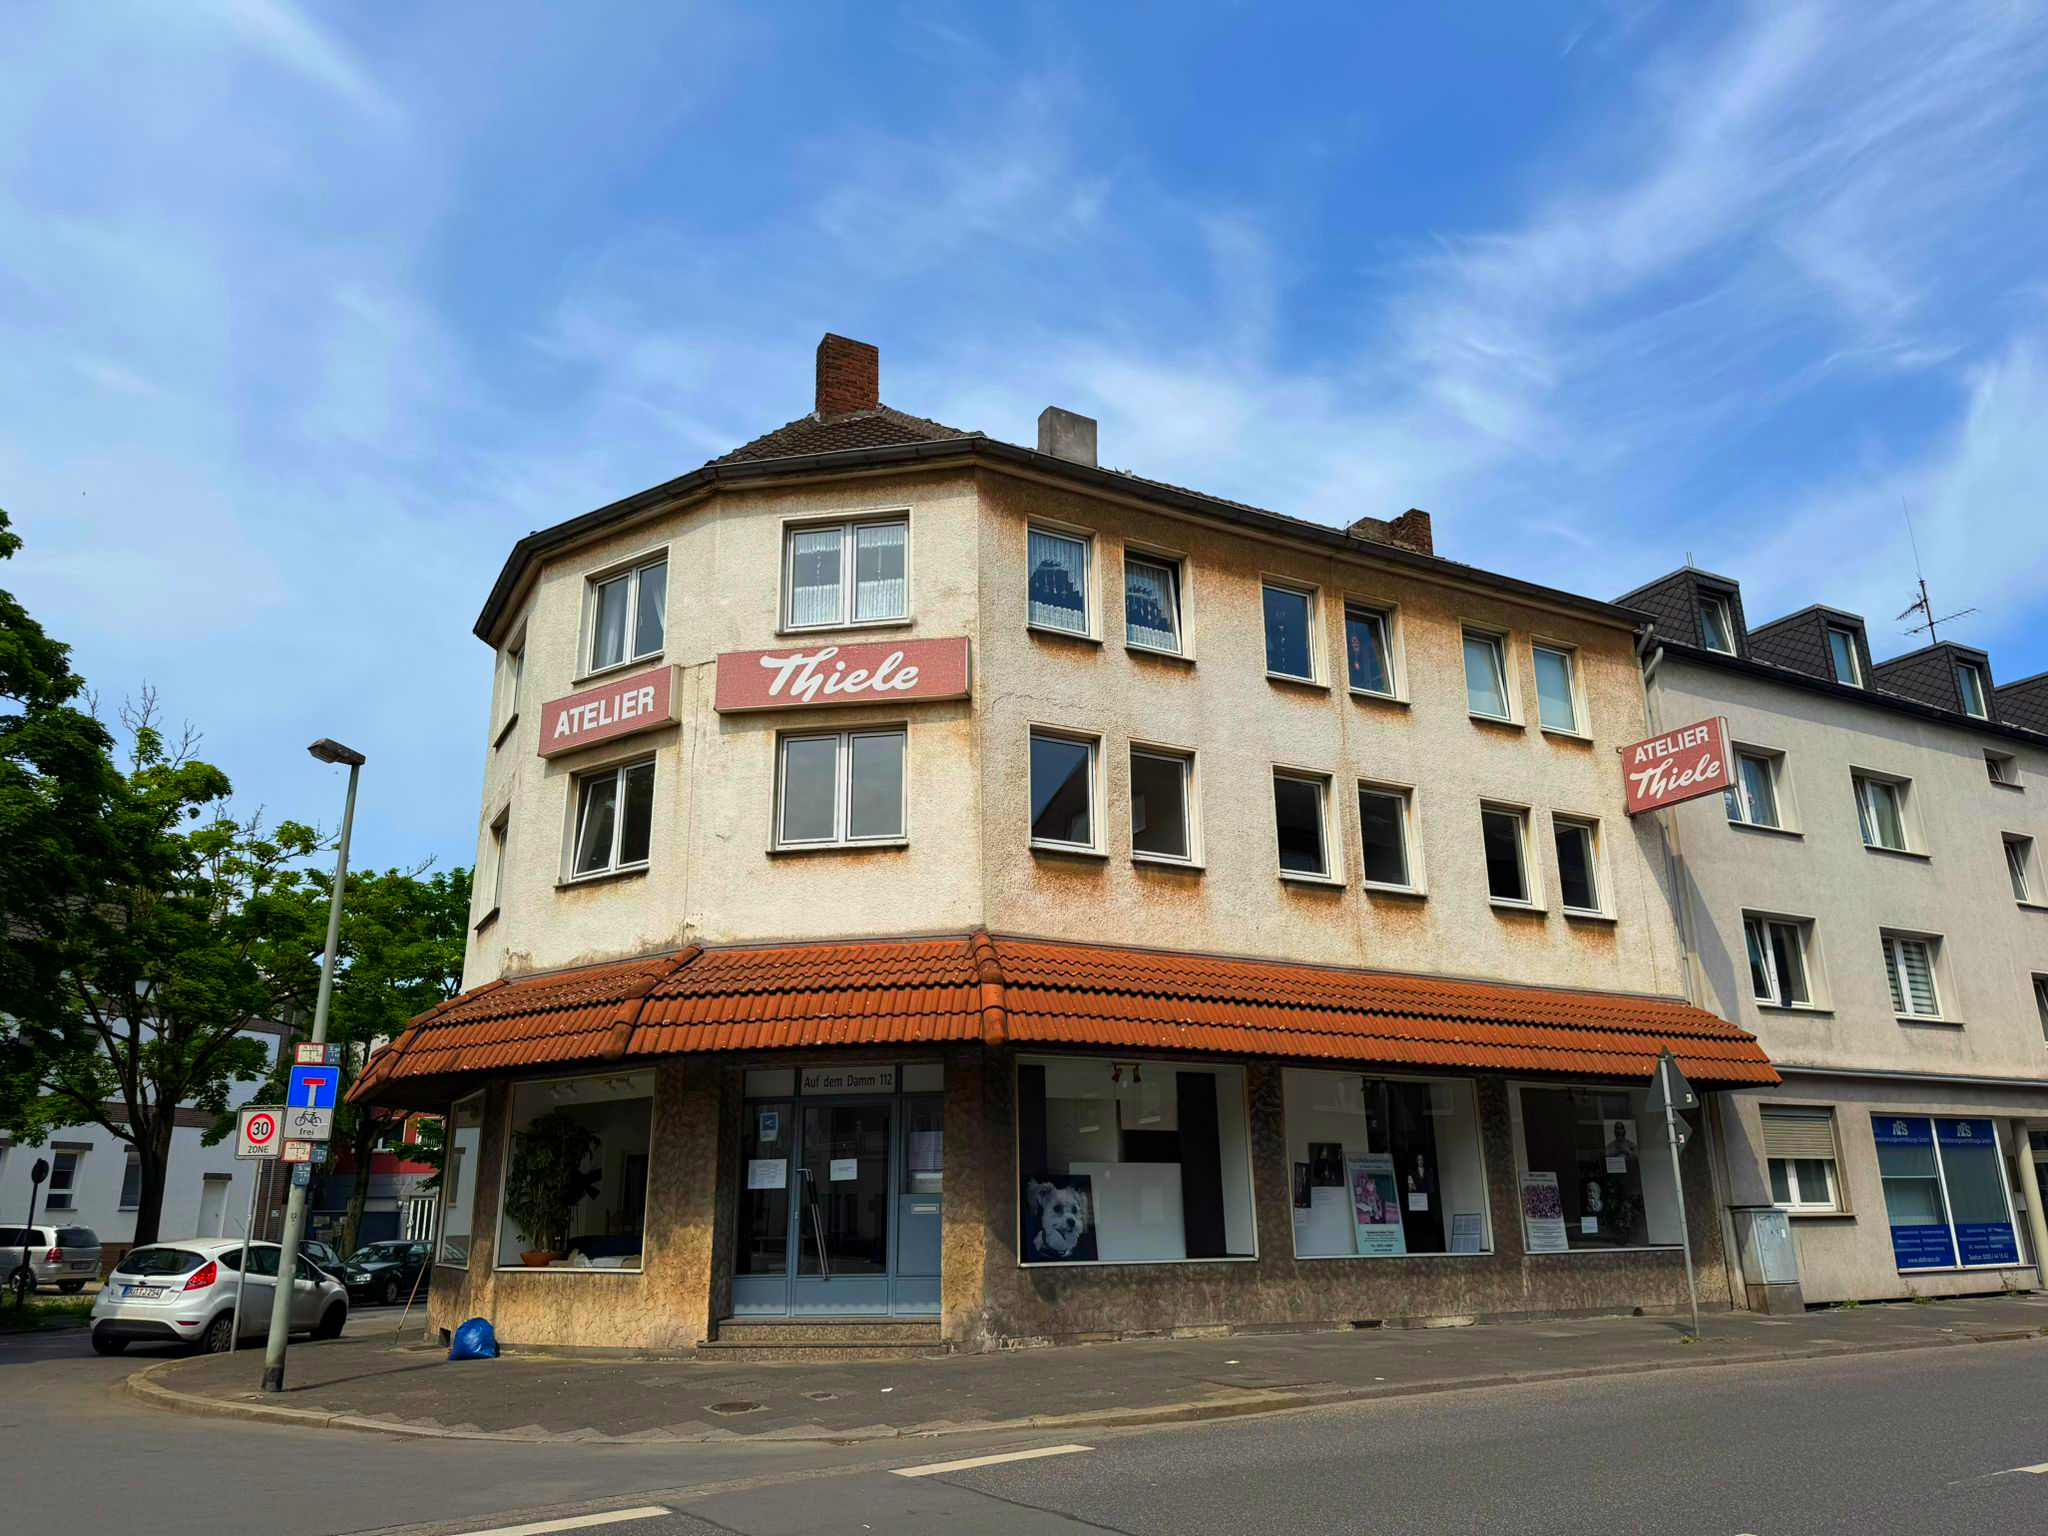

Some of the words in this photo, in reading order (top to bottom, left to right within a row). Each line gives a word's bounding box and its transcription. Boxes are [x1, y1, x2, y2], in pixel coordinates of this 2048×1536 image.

[759, 646, 919, 702] Thiele
[553, 685, 655, 739] ATELIER
[1633, 724, 1710, 764] ATELIER
[1629, 752, 1721, 800] Thiele
[803, 1075, 820, 1088] Auf
[823, 1075, 843, 1088] dem
[847, 1074, 876, 1087] Damm
[879, 1073, 893, 1086] 112
[252, 1121, 269, 1136] 30
[299, 1127, 315, 1136] frei
[247, 1145, 270, 1154] ZONE
